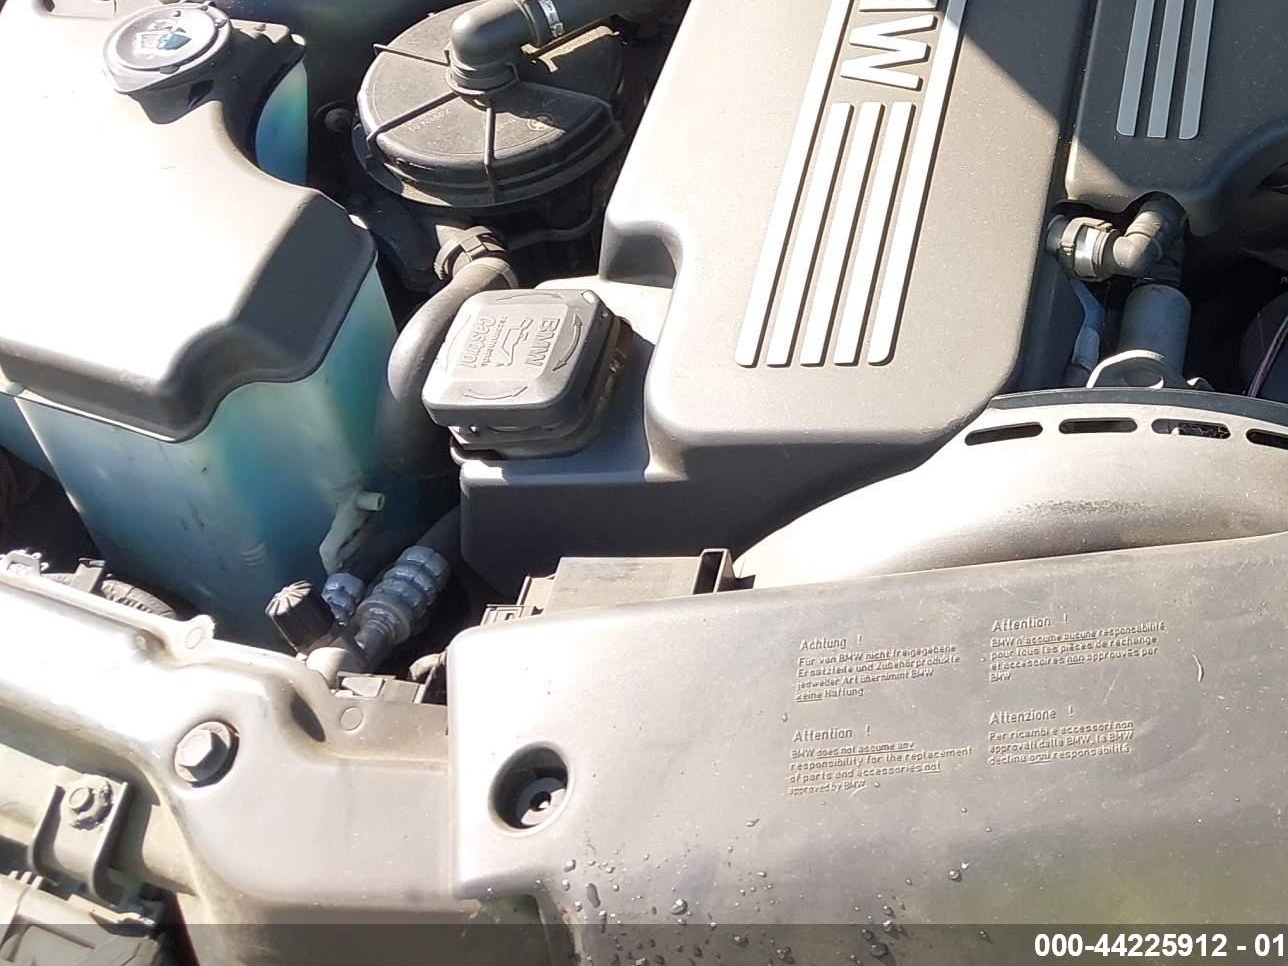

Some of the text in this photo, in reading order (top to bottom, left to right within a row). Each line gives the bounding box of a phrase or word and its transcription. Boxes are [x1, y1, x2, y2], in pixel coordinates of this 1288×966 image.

[524, 316, 561, 367] BMW
[992, 617, 1051, 632] Attention
[800, 637, 847, 650] Achtung
[991, 638, 1015, 647] BMW
[989, 708, 1057, 725] Attenzione
[793, 727, 853, 742] Attention
